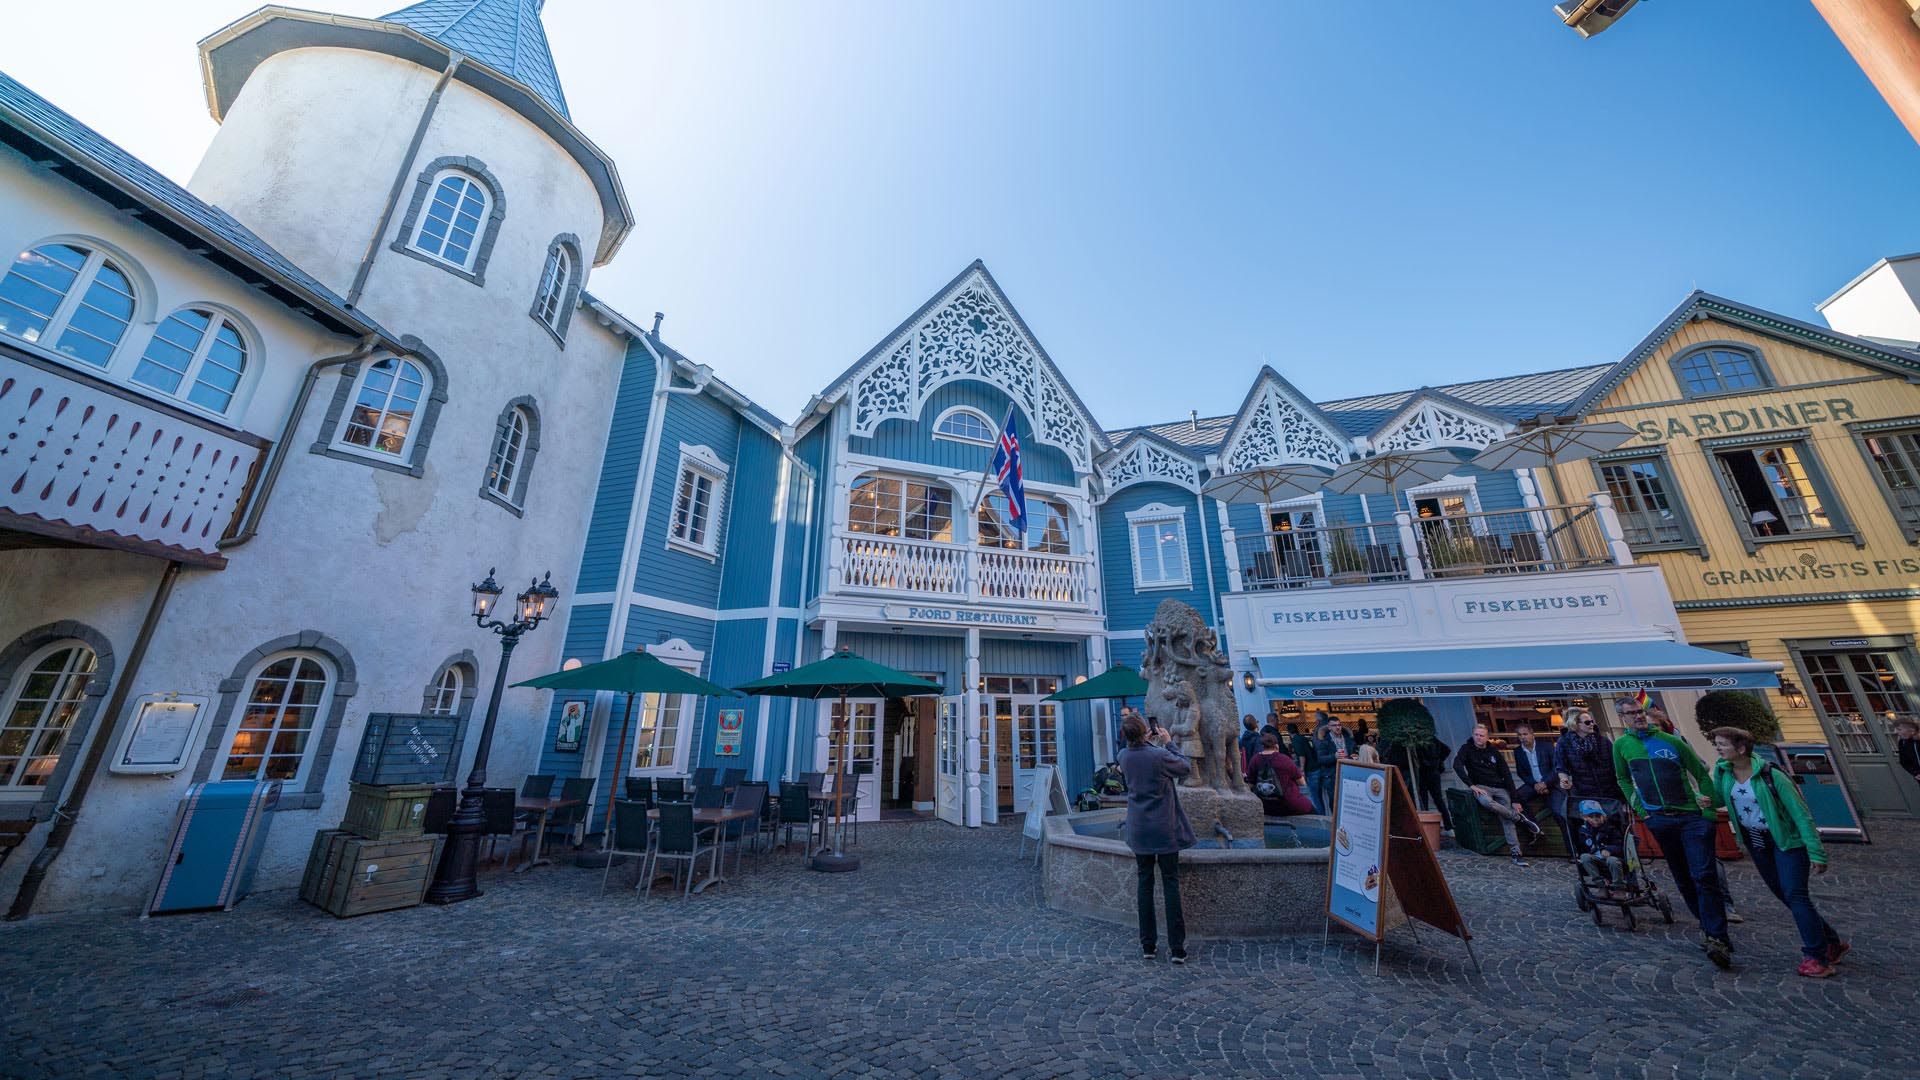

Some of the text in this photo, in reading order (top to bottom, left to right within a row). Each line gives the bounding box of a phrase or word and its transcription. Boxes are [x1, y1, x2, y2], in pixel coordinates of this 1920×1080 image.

[1636, 398, 1860, 442] SARDINER
[1702, 558, 1920, 586] GRANKVISTS FIS
[1464, 594, 1609, 614] FISKEHUSET
[909, 607, 1037, 626] FJORD RESTAURANT
[1272, 607, 1398, 624] FISKEHUSET
[1357, 686, 1439, 696] FISKEHUSET
[1561, 679, 1655, 691] FISKEHUSET
